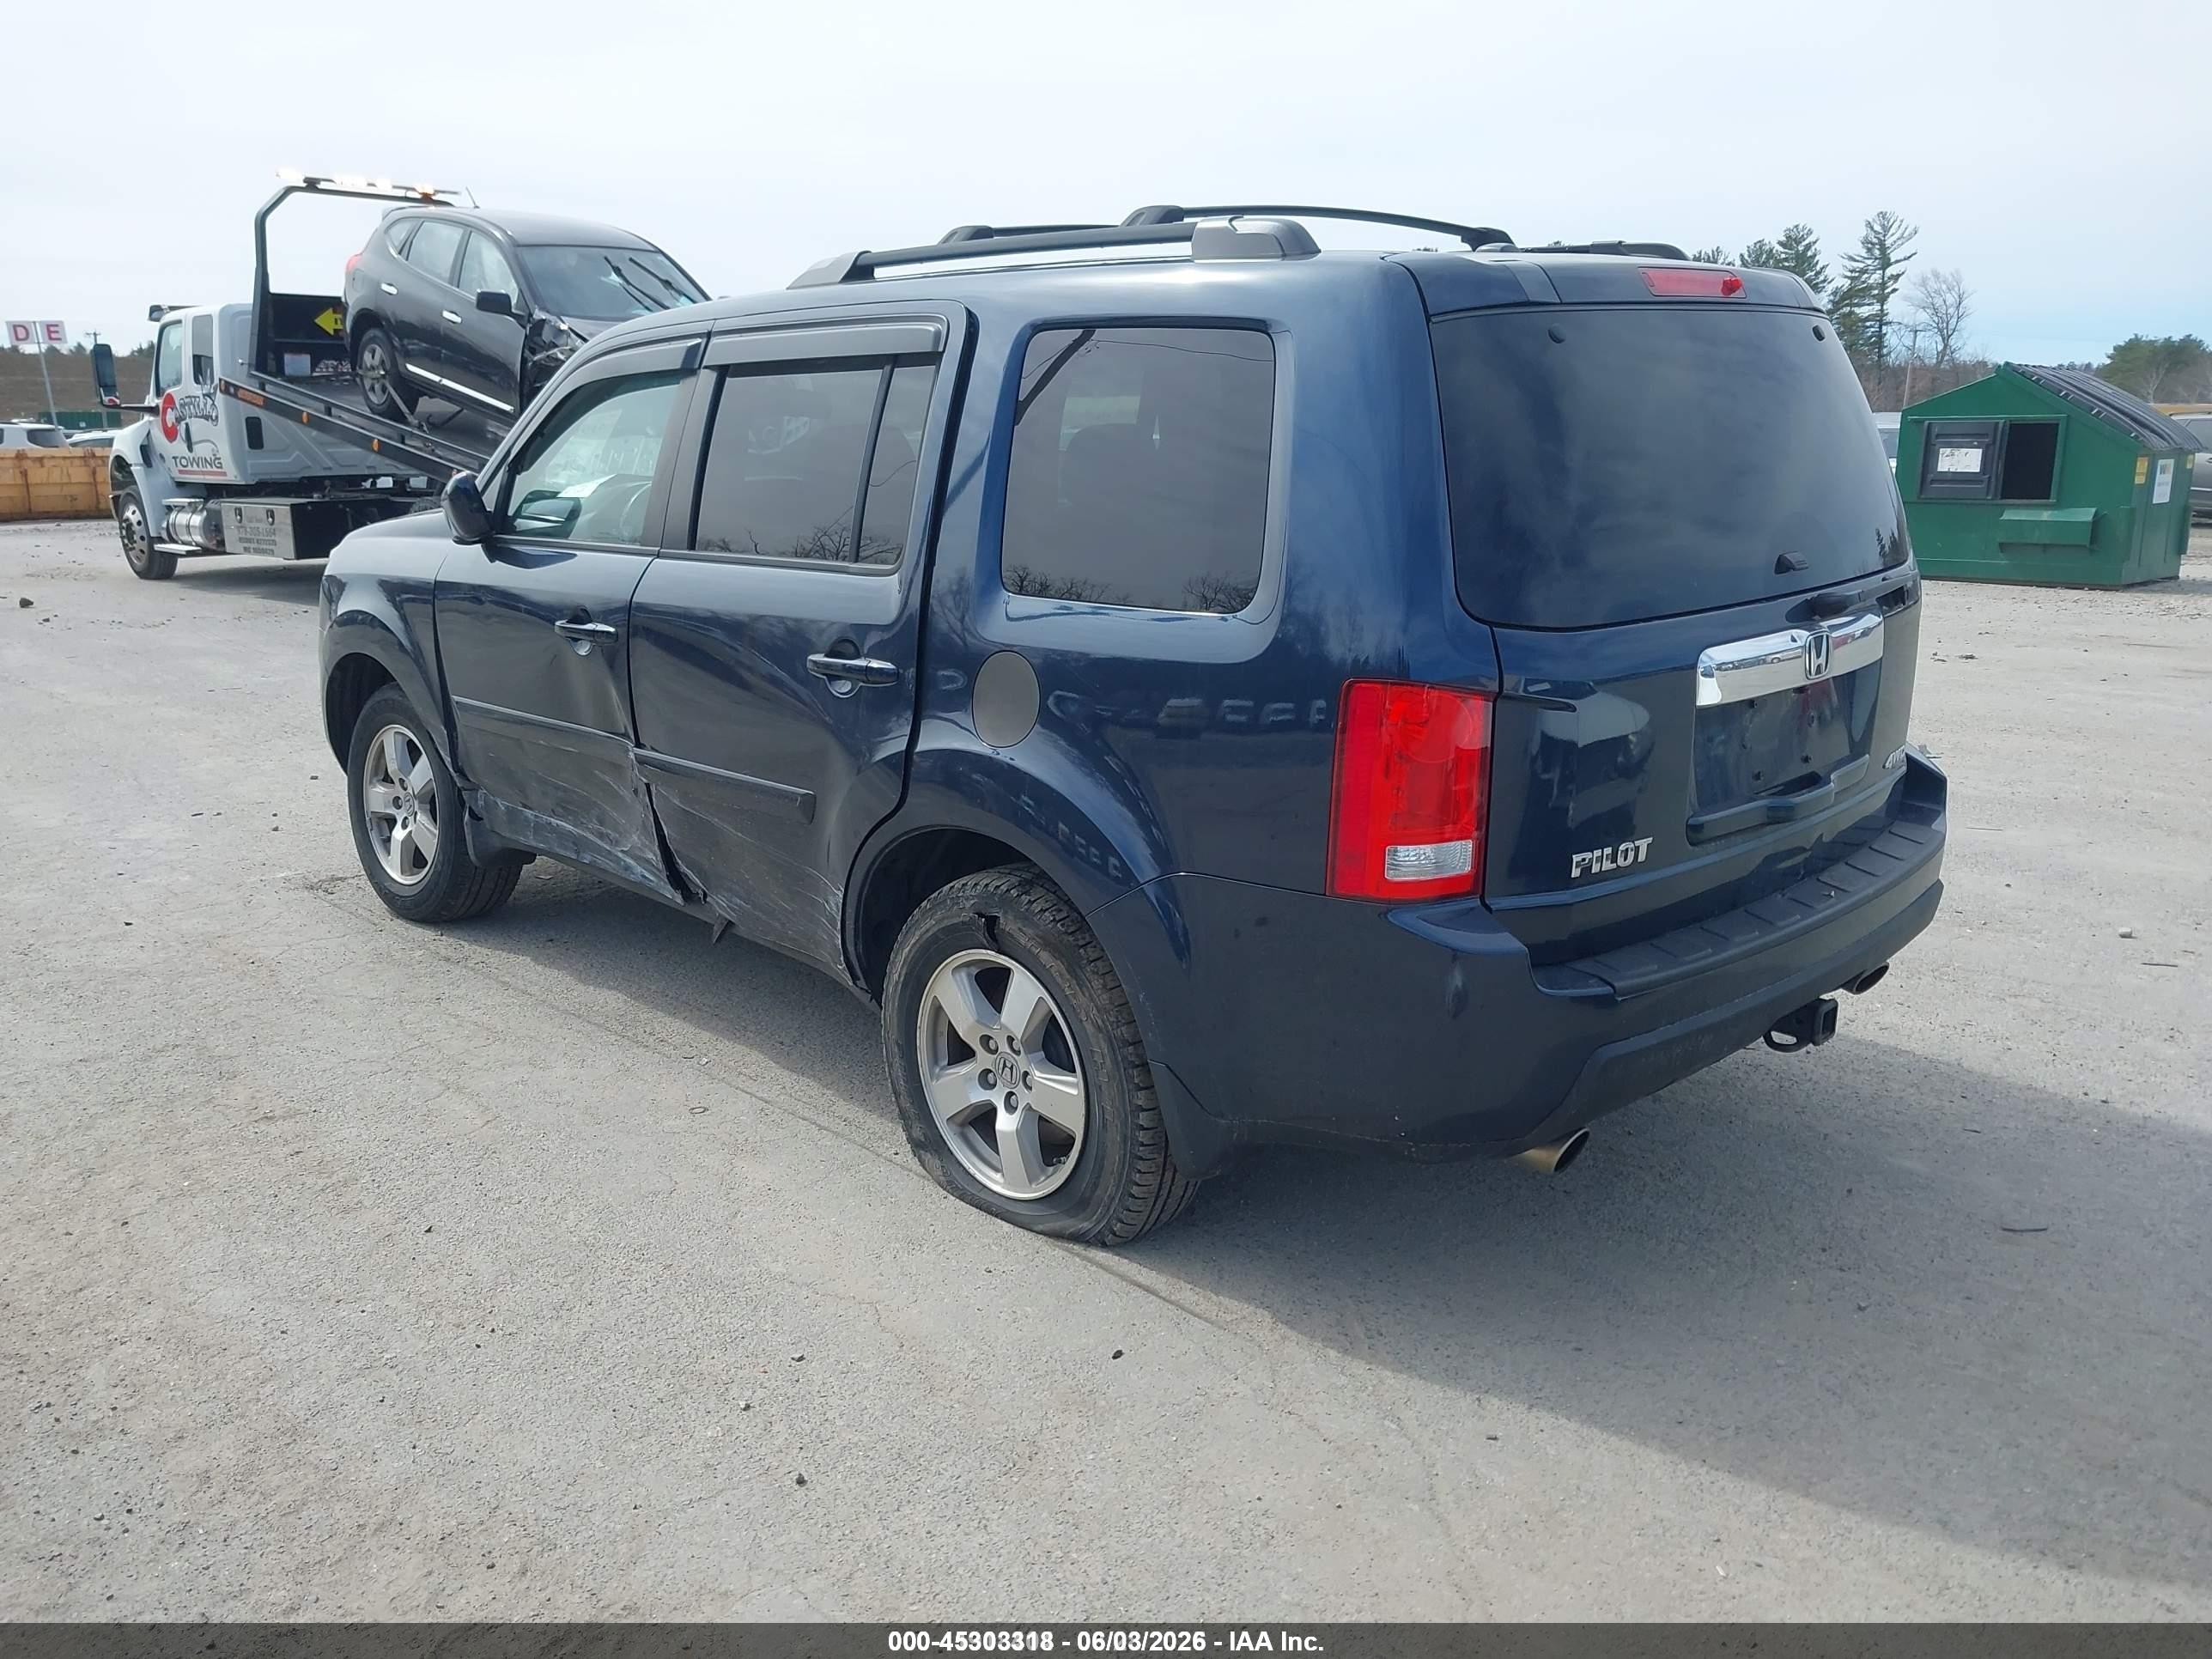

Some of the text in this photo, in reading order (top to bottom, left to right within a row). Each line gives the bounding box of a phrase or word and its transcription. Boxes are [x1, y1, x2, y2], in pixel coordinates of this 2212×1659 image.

[12, 324, 30, 342] D
[46, 323, 63, 341] E
[172, 455, 223, 470] TOWING
[1571, 836, 1654, 878] PILOT
